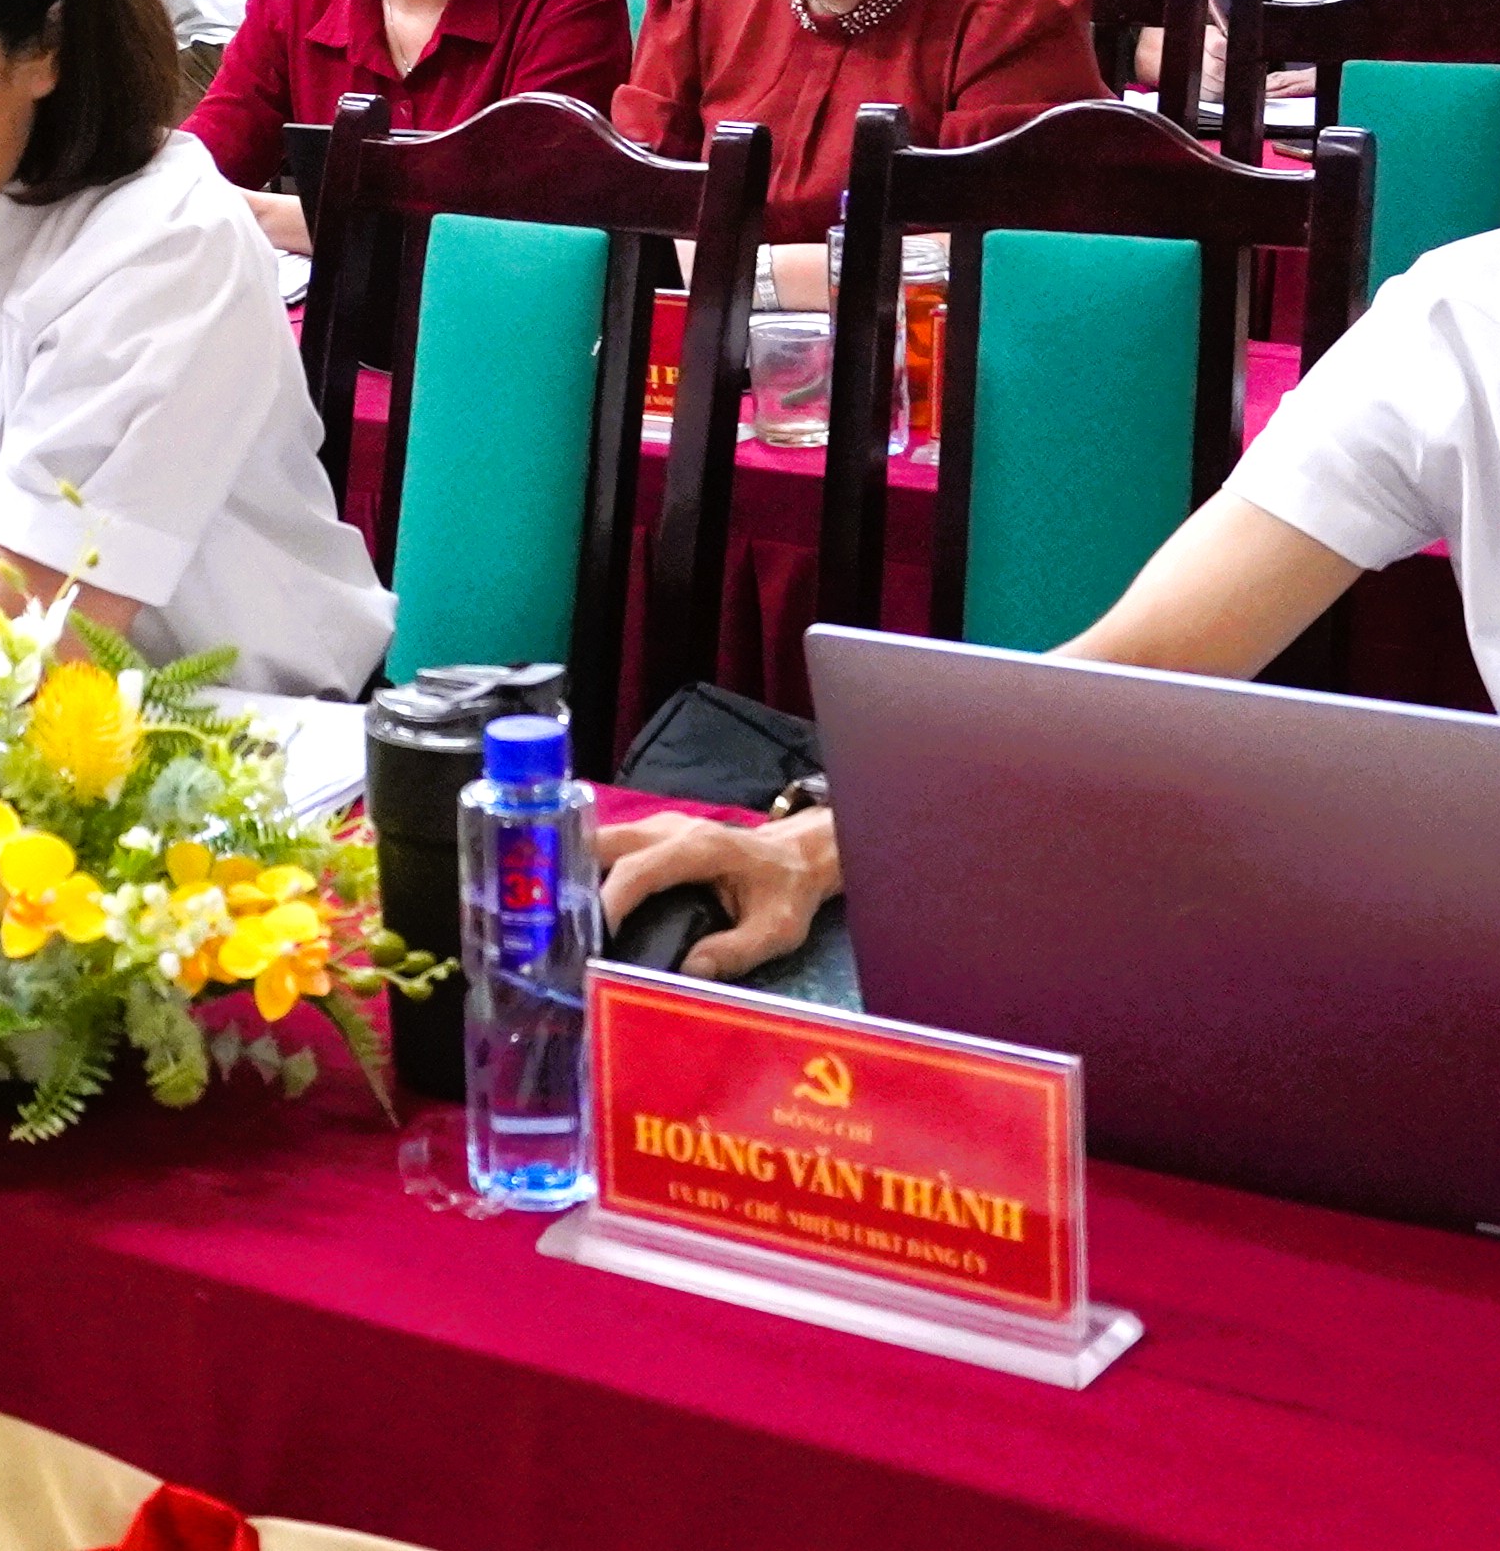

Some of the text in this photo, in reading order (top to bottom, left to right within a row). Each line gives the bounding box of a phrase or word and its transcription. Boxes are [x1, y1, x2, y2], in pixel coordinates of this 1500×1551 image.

[634, 1113, 1025, 1243] HOÀNG VĂN THÀNH
